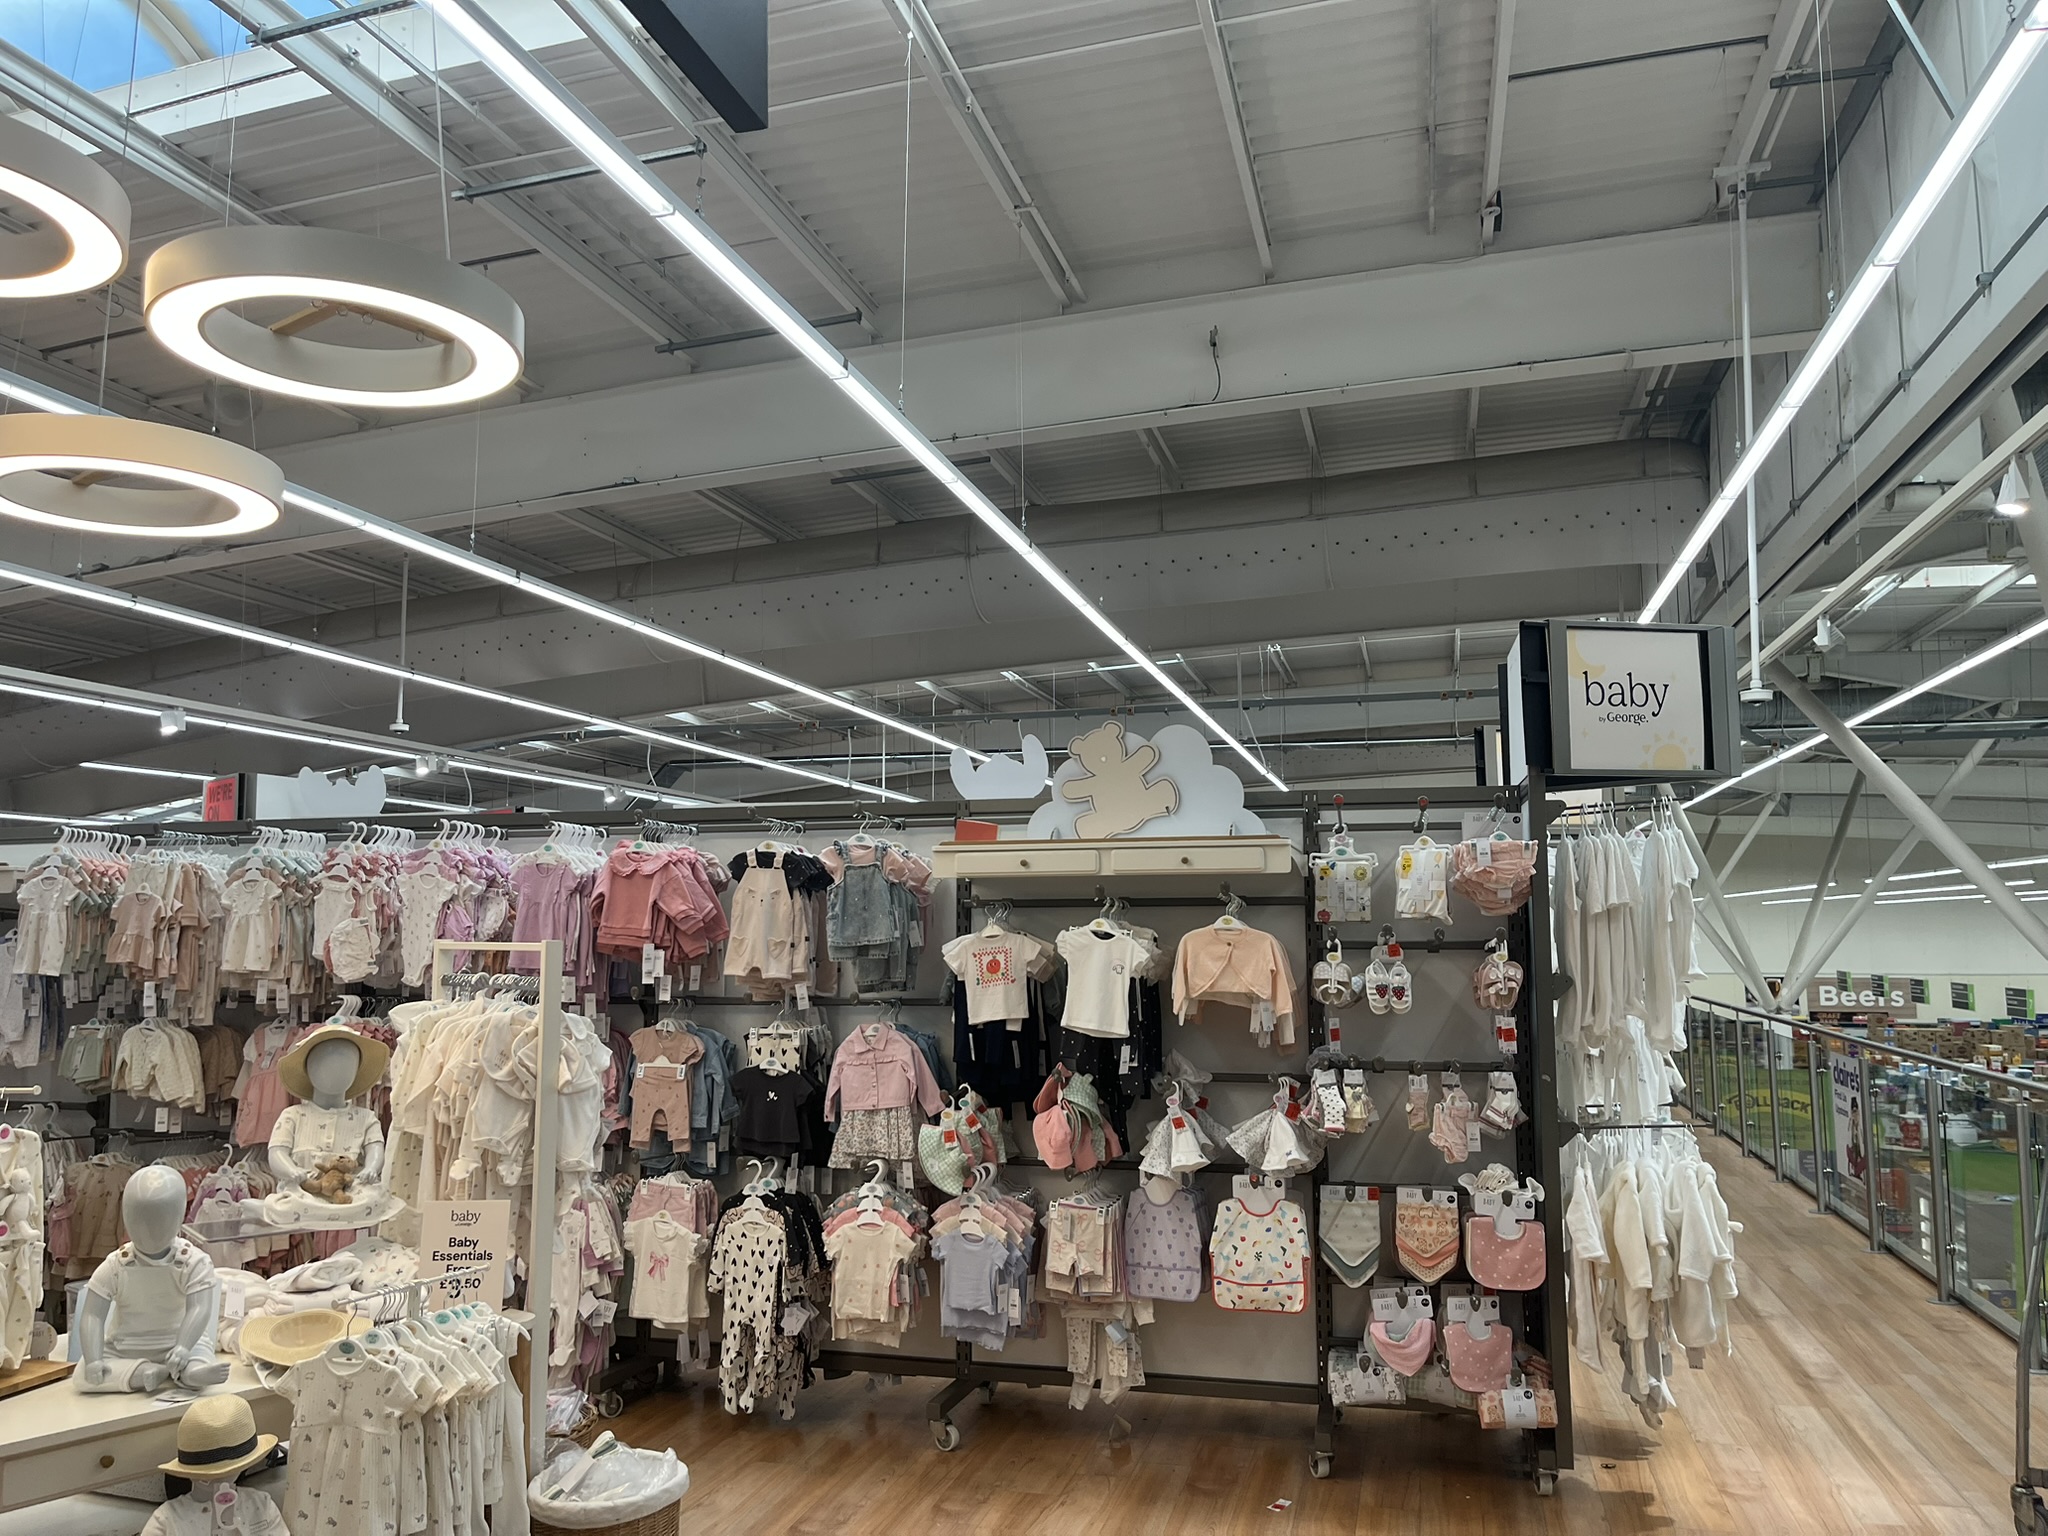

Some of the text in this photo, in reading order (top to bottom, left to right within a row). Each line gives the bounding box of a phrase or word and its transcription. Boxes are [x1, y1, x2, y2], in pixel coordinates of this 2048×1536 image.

[1582, 670, 1669, 717] baby
[1606, 711, 1649, 726] George.
[209, 783, 232, 803] WE'RE
[208, 804, 220, 820] ON
[451, 1209, 481, 1224] baby
[448, 1237, 479, 1250] Baby
[432, 1250, 493, 1261] Essentials
